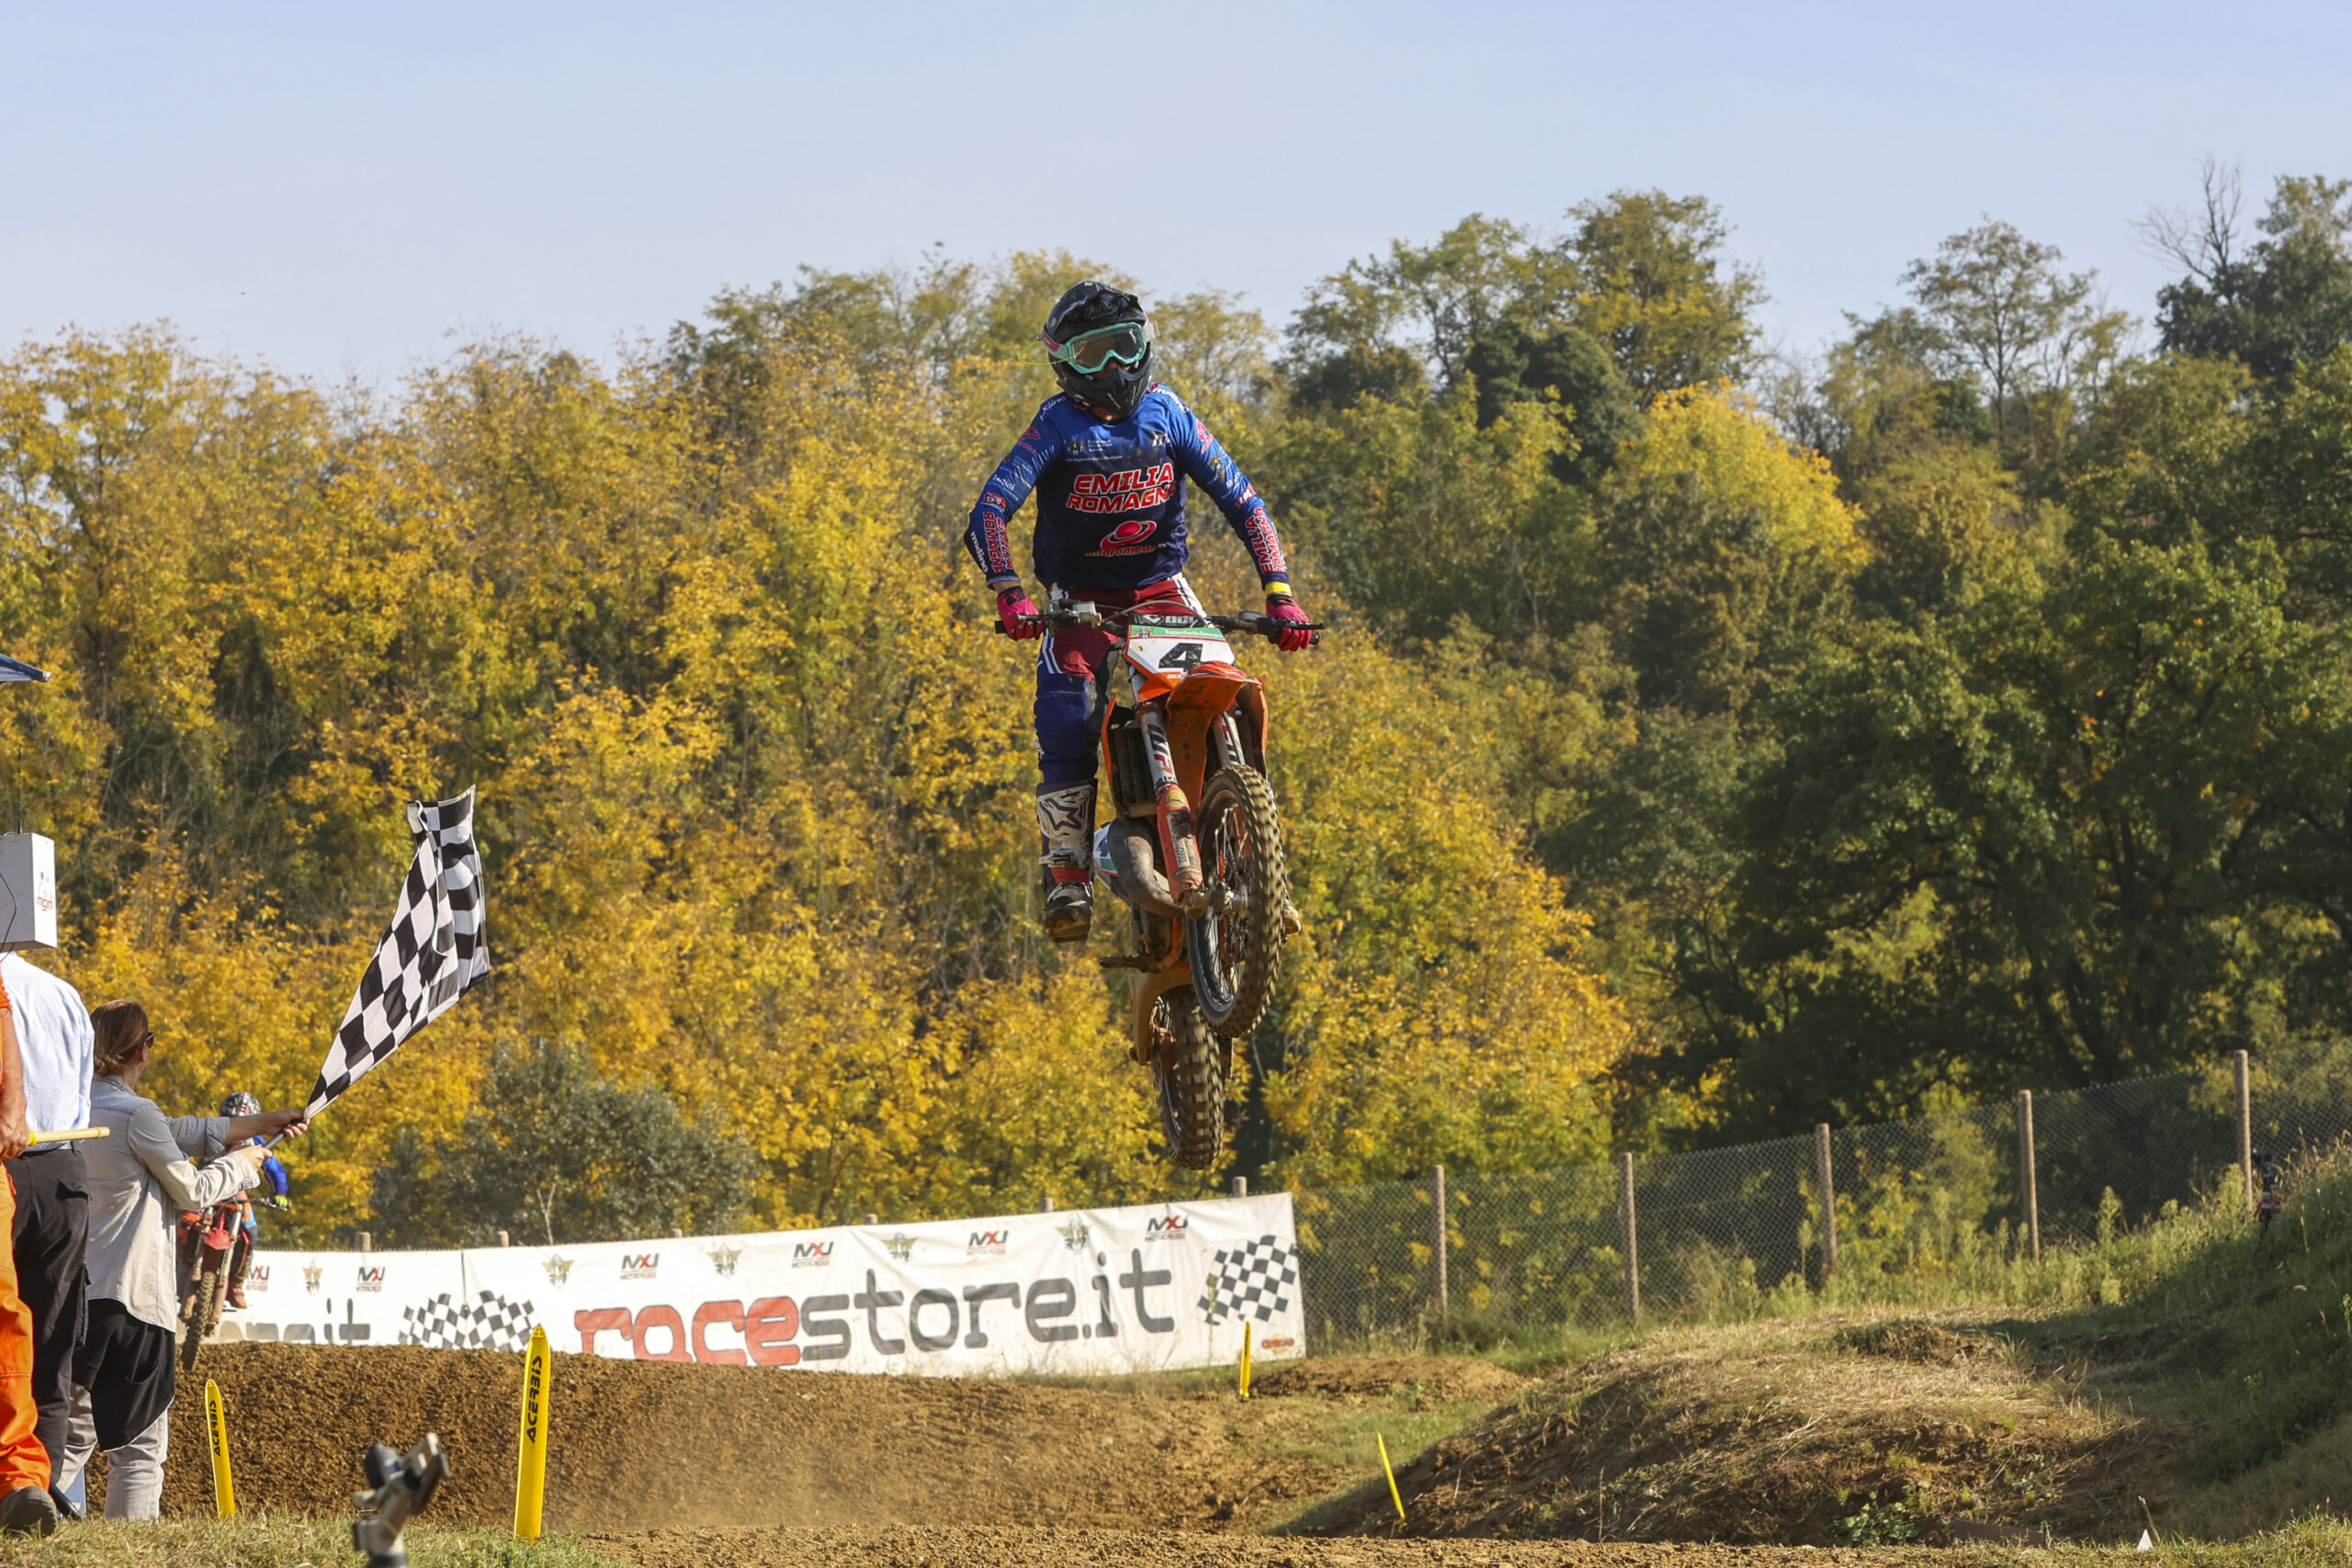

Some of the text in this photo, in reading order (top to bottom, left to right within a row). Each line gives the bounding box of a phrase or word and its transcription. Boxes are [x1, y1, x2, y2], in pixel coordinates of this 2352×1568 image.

[1074, 463, 1174, 494] EMILIA
[1245, 515, 1274, 574] EMILIA
[1159, 643, 1203, 673] 4
[574, 1248, 1175, 1368] racestore.it
